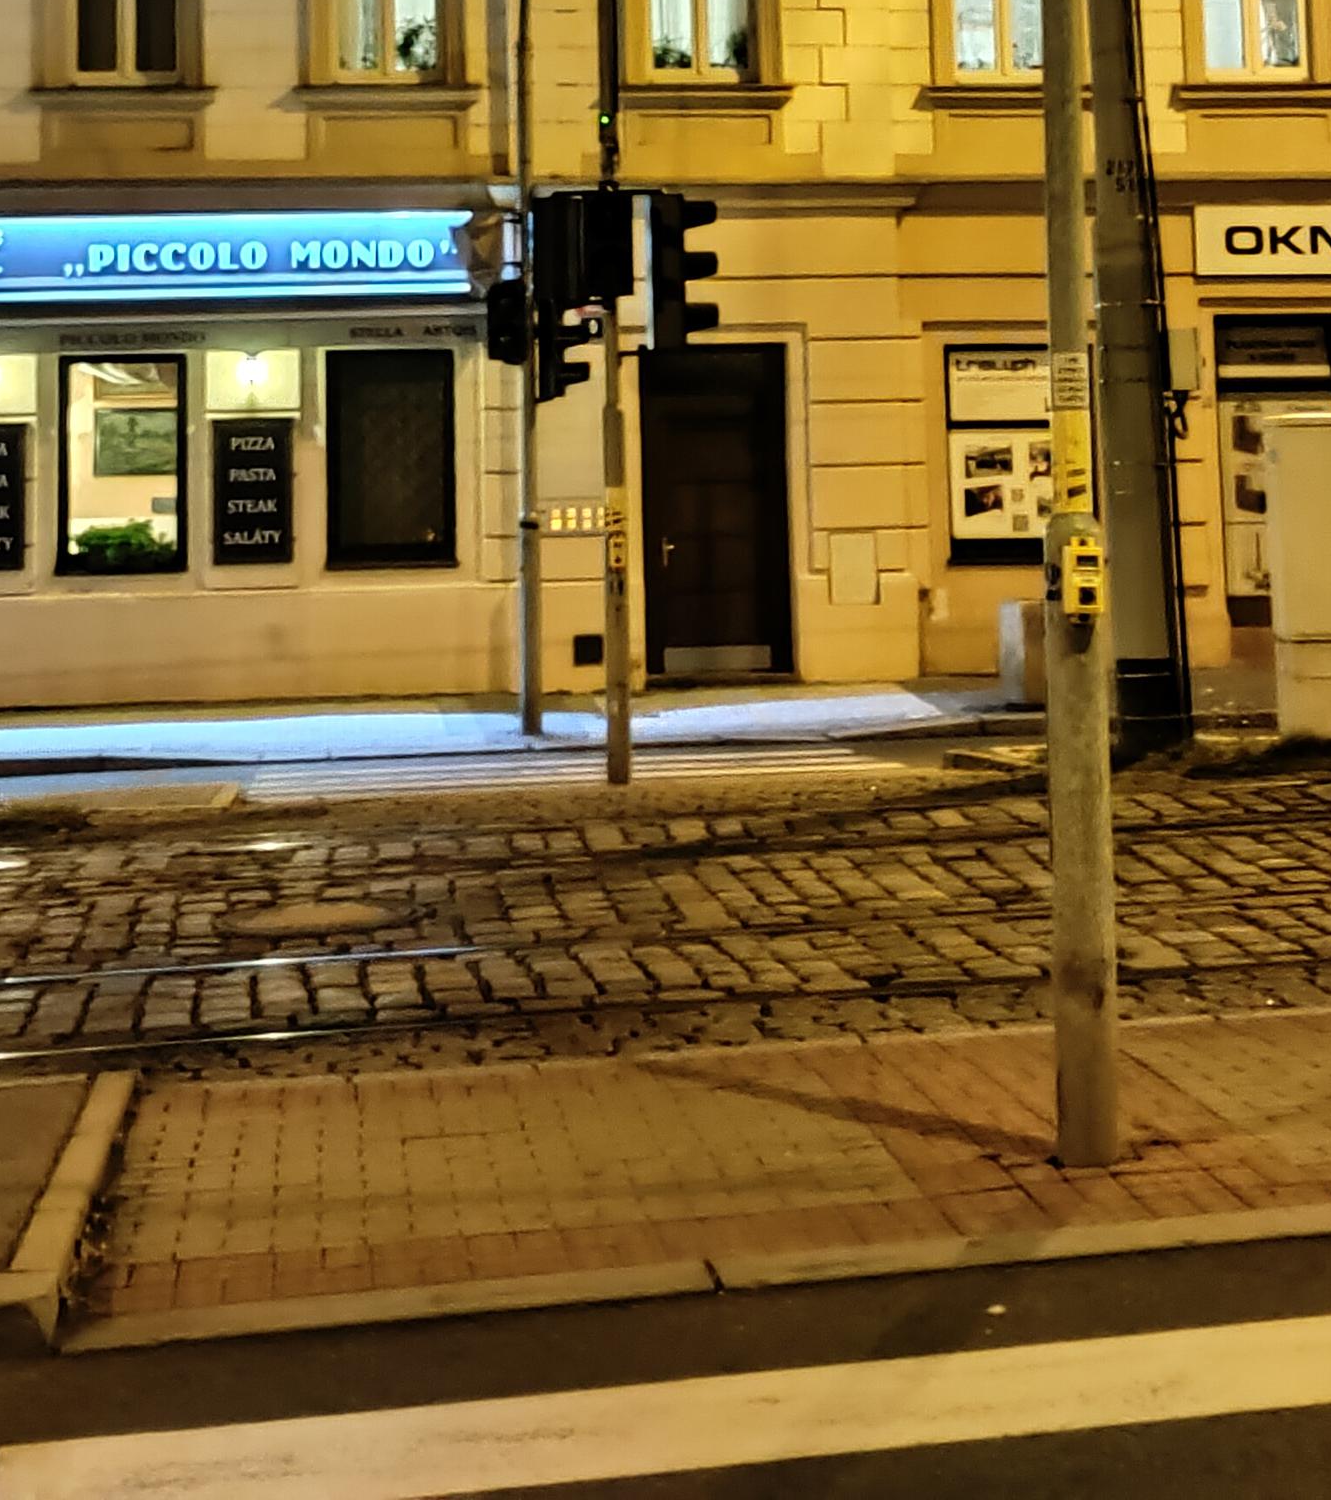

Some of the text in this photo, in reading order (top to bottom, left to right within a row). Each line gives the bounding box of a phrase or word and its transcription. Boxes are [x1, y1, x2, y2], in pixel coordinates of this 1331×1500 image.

[230, 436, 276, 451] PIZZA
[229, 467, 276, 483] PASTA
[227, 499, 277, 514] STEAK
